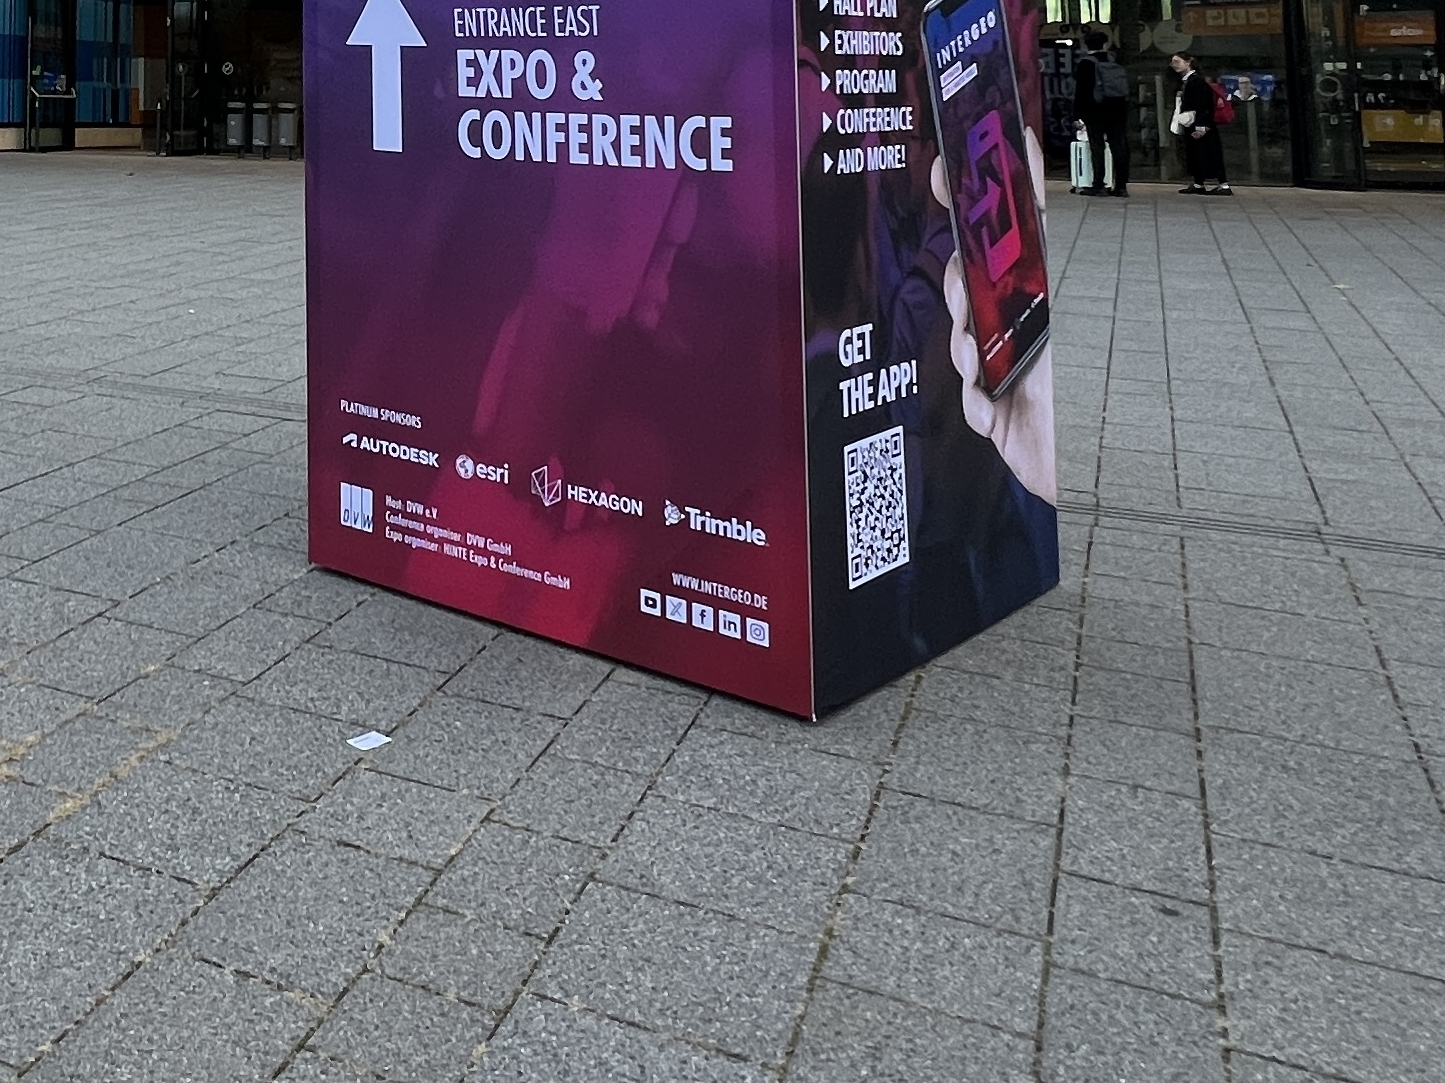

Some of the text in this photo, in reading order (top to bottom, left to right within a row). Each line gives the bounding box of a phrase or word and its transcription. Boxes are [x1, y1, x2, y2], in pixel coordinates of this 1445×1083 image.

[453, 5, 600, 38] ENTRANCE EAST
[834, 30, 903, 56] EXHIBITORS
[456, 48, 604, 101] EXPO &
[835, 69, 896, 94] PROGRAM
[836, 106, 914, 135] CONFERENCE
[458, 108, 734, 172] CONFERENCE
[836, 145, 906, 175] AND MORE!
[838, 323, 873, 367] GET
[839, 359, 918, 418] THE APP!
[340, 399, 422, 429] PLATINUM SPONSORS
[359, 436, 440, 468] AUTODESK
[476, 463, 509, 484] esri
[567, 484, 643, 517] HEXAGON
[684, 506, 766, 546] Trimble
[385, 526, 403, 543] Expo
[469, 550, 488, 567] Expo
[544, 571, 570, 590] GmbH
[486, 537, 512, 557] GmbH
[672, 572, 767, 611] WWW.INTERGEO.DE
